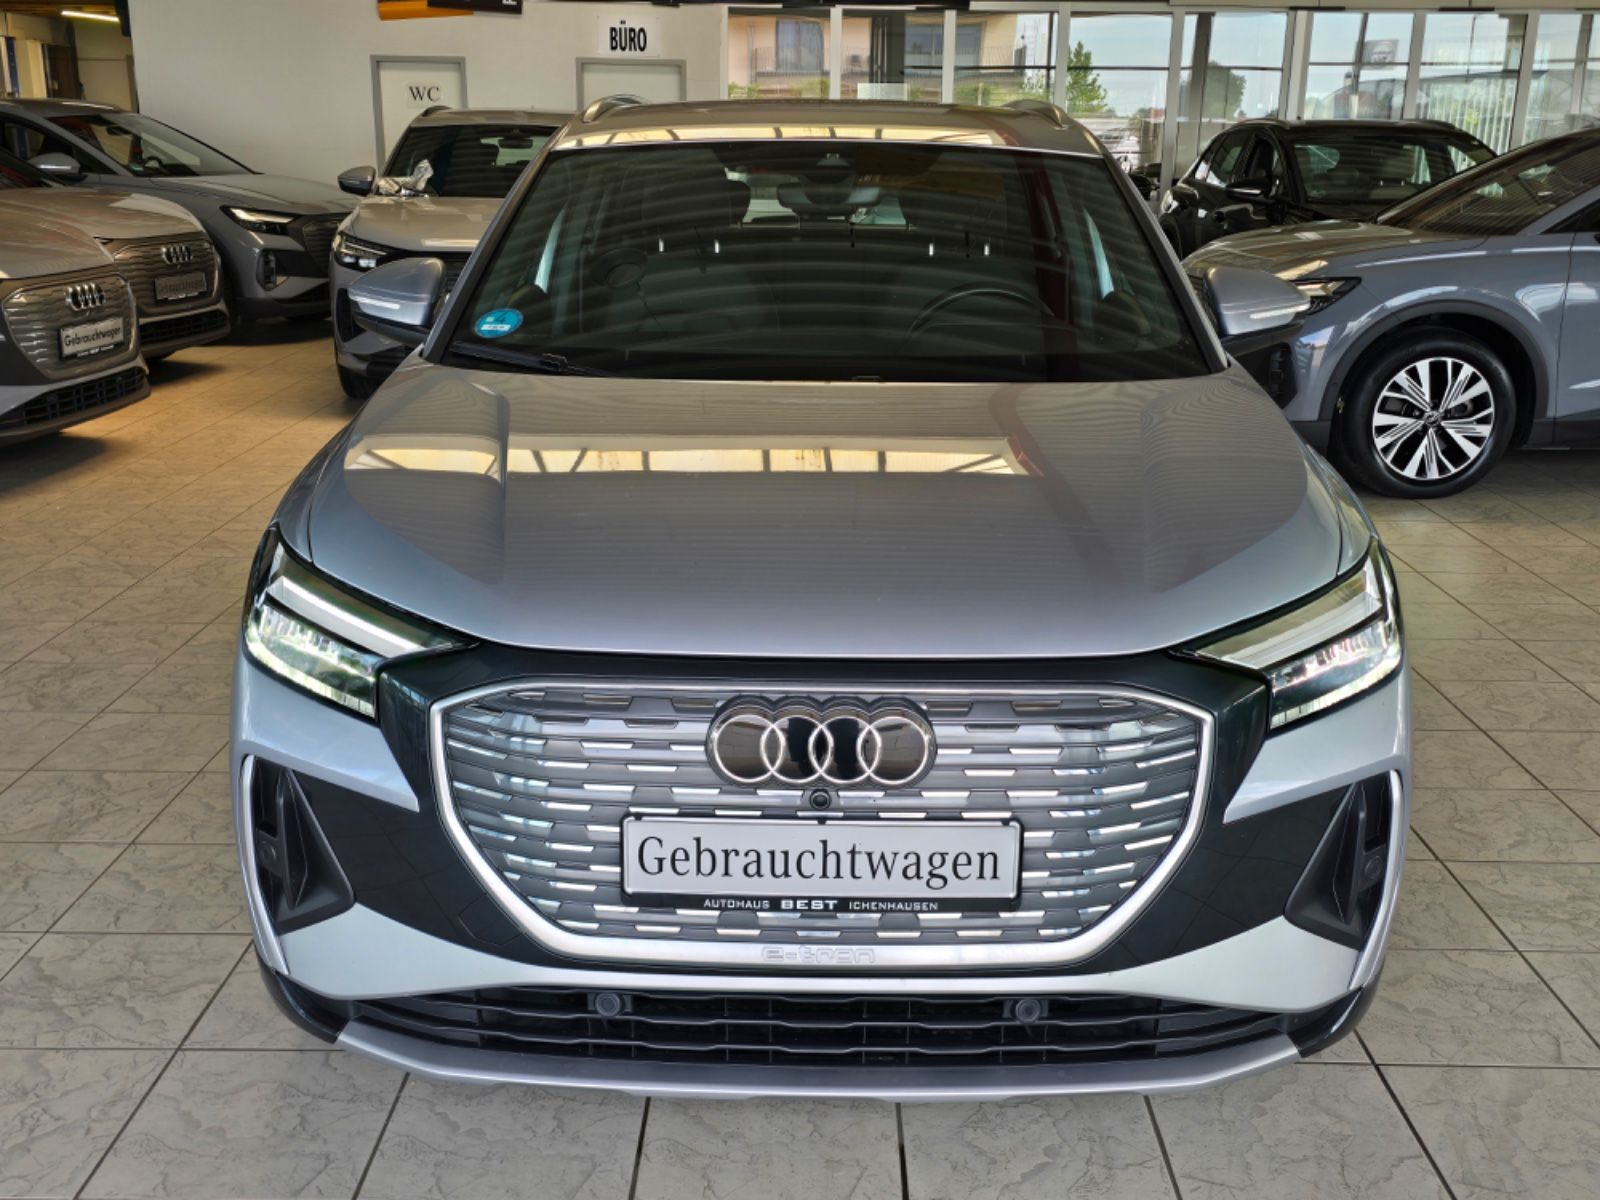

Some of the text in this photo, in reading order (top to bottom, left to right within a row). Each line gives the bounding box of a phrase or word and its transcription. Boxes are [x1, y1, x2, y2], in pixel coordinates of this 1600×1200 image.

[610, 20, 647, 52] BÜRO
[409, 86, 441, 102] WC
[637, 836, 1001, 890] Gebrauchtwagen
[703, 898, 939, 911] AUTOHAUS BEST ICHENHAUSEN
[761, 945, 876, 965] e-tron
